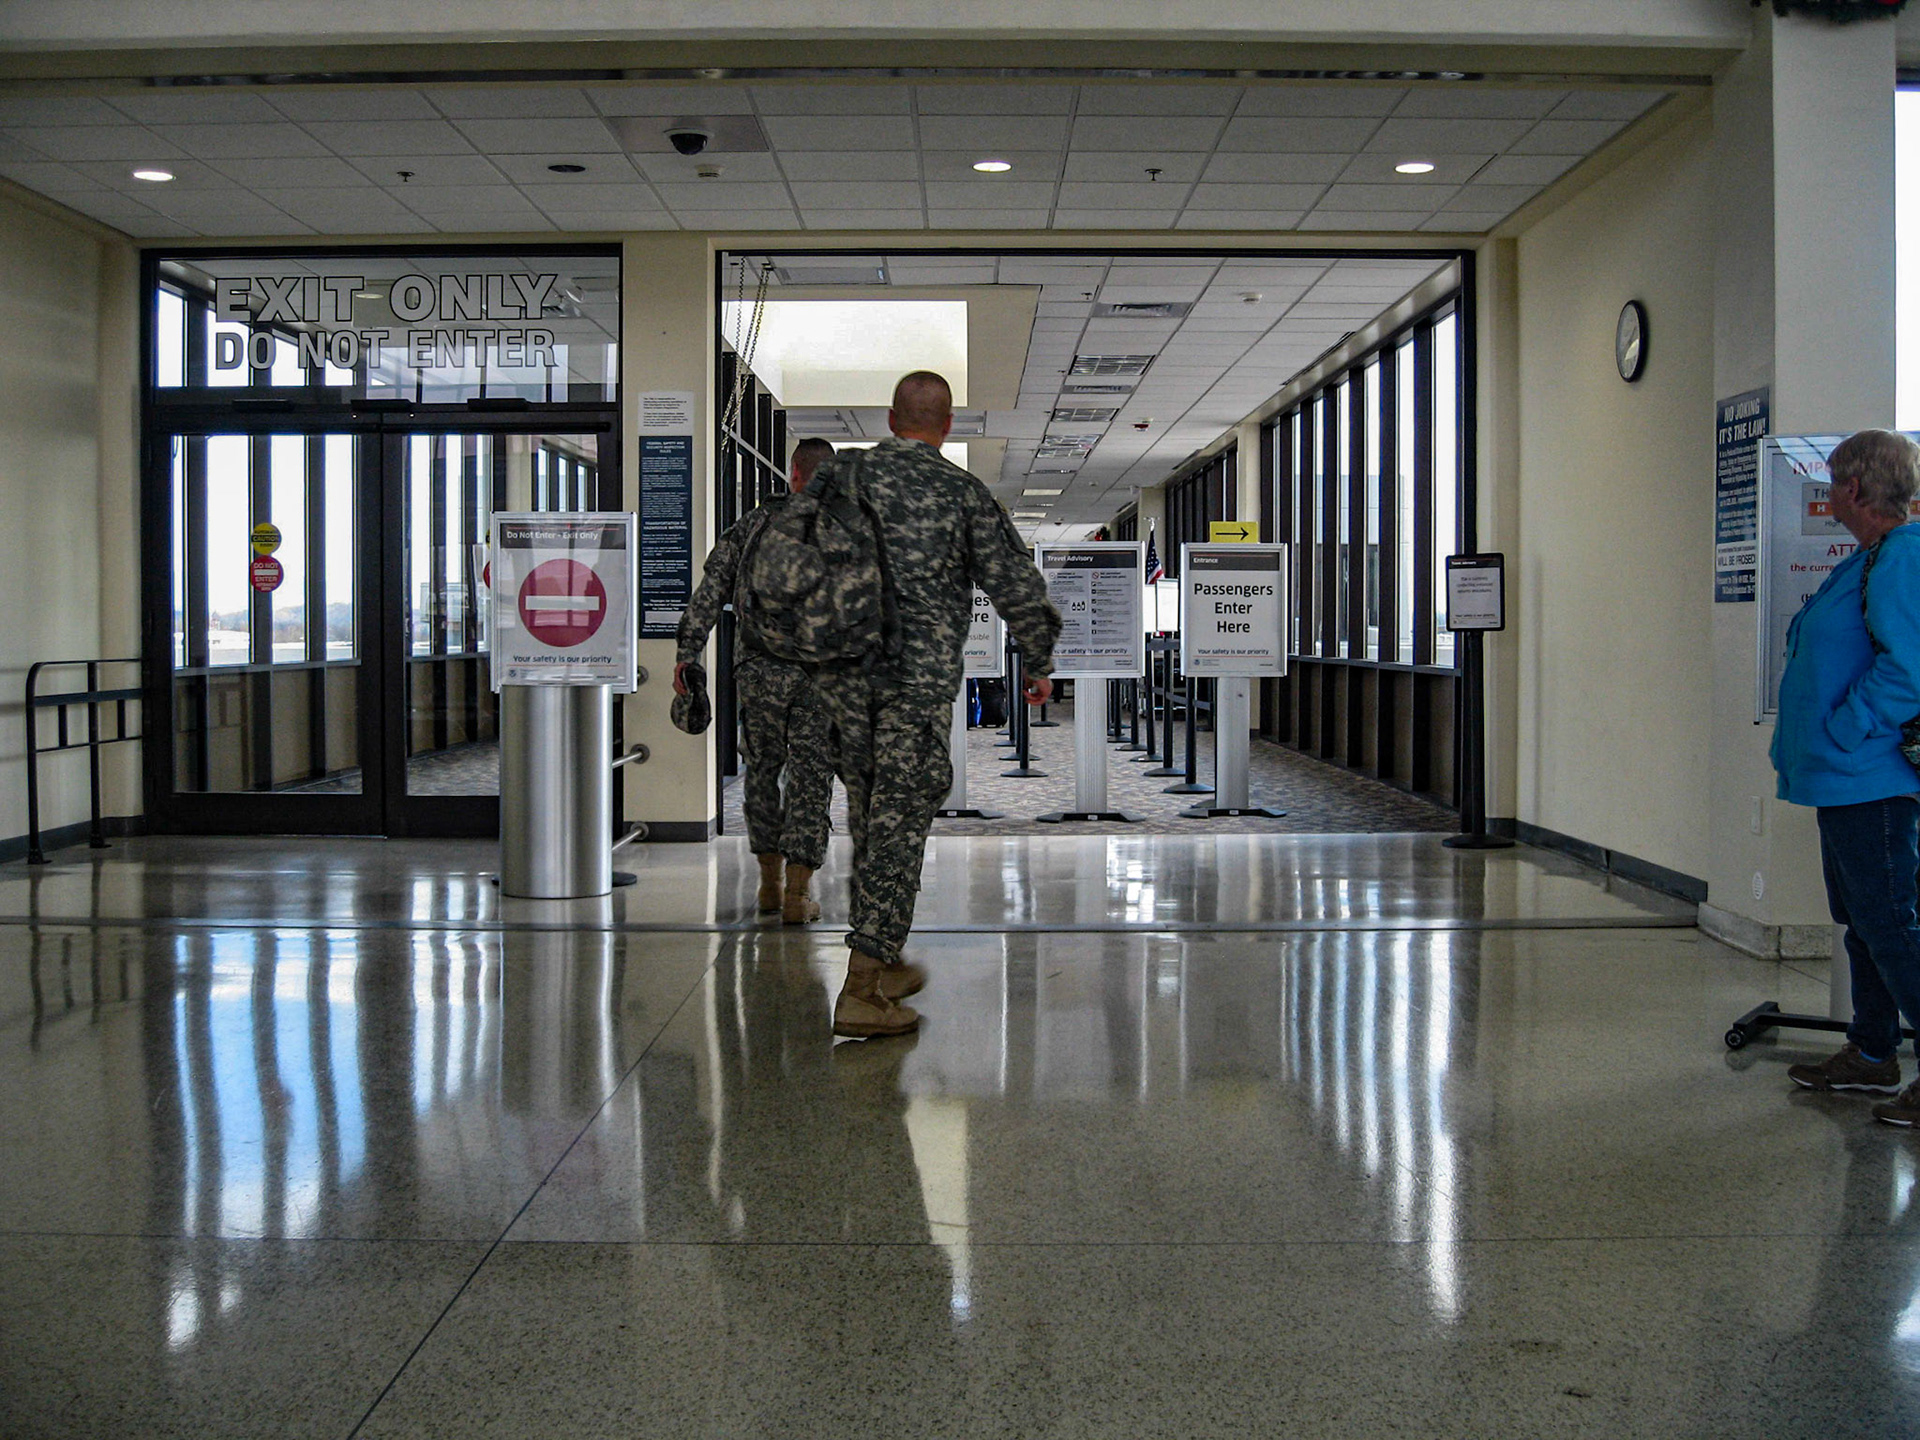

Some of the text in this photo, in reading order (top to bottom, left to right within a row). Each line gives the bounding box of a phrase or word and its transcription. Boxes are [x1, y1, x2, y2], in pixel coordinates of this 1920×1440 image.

[215, 273, 558, 323] EXIT ONLY
[215, 328, 558, 370] DO NOT ENTER
[1724, 398, 1760, 423] NO JOKING
[1734, 422, 1747, 441] THE
[507, 531, 519, 539] Do
[520, 531, 533, 539] Not
[535, 531, 556, 539] Enter
[563, 531, 578, 539] Exit
[580, 531, 598, 540] Only
[1790, 564, 1807, 572] the
[1194, 583, 1273, 597] Passengers
[1215, 602, 1252, 614] Enter
[1217, 621, 1251, 633] Here
[533, 655, 557, 663] safety
[582, 655, 612, 663] priority
